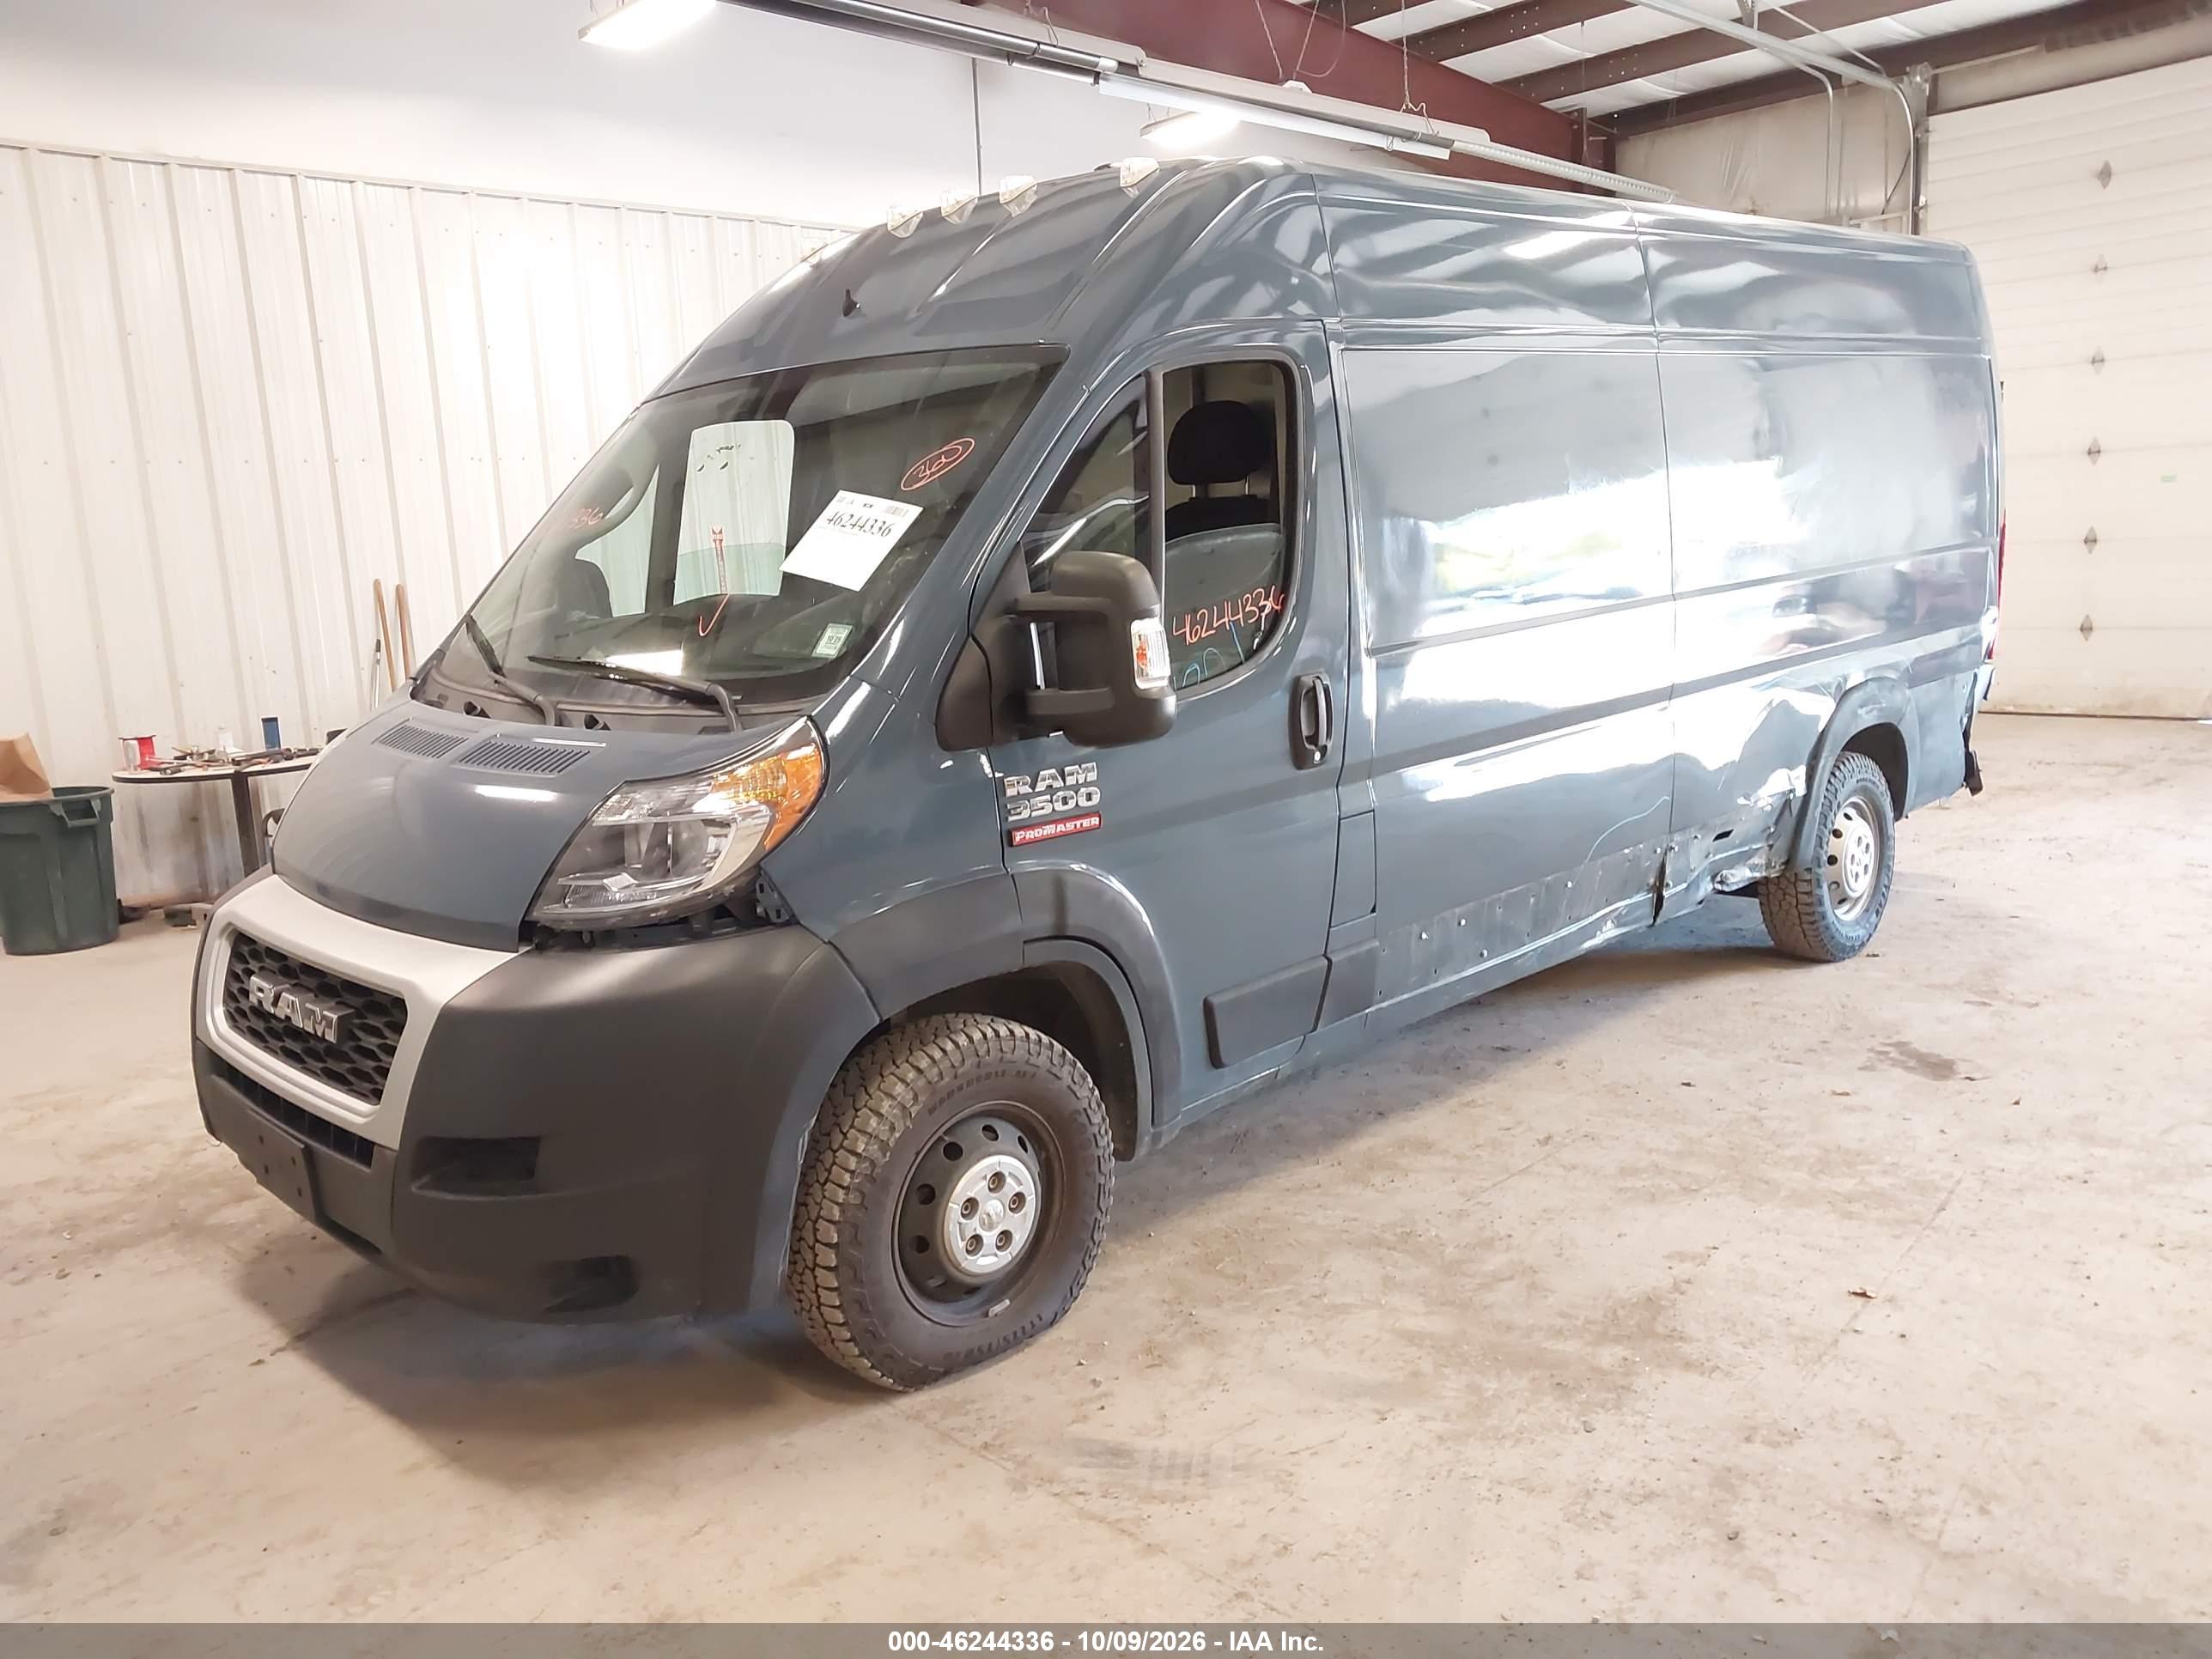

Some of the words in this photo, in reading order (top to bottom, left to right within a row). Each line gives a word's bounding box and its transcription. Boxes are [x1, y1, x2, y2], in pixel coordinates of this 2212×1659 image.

[827, 510, 896, 538] 46244336
[1004, 762, 1097, 797] RAM
[1006, 787, 1101, 822] 3500
[1015, 817, 1100, 842] PROMASTER
[249, 974, 350, 1043] RAM
